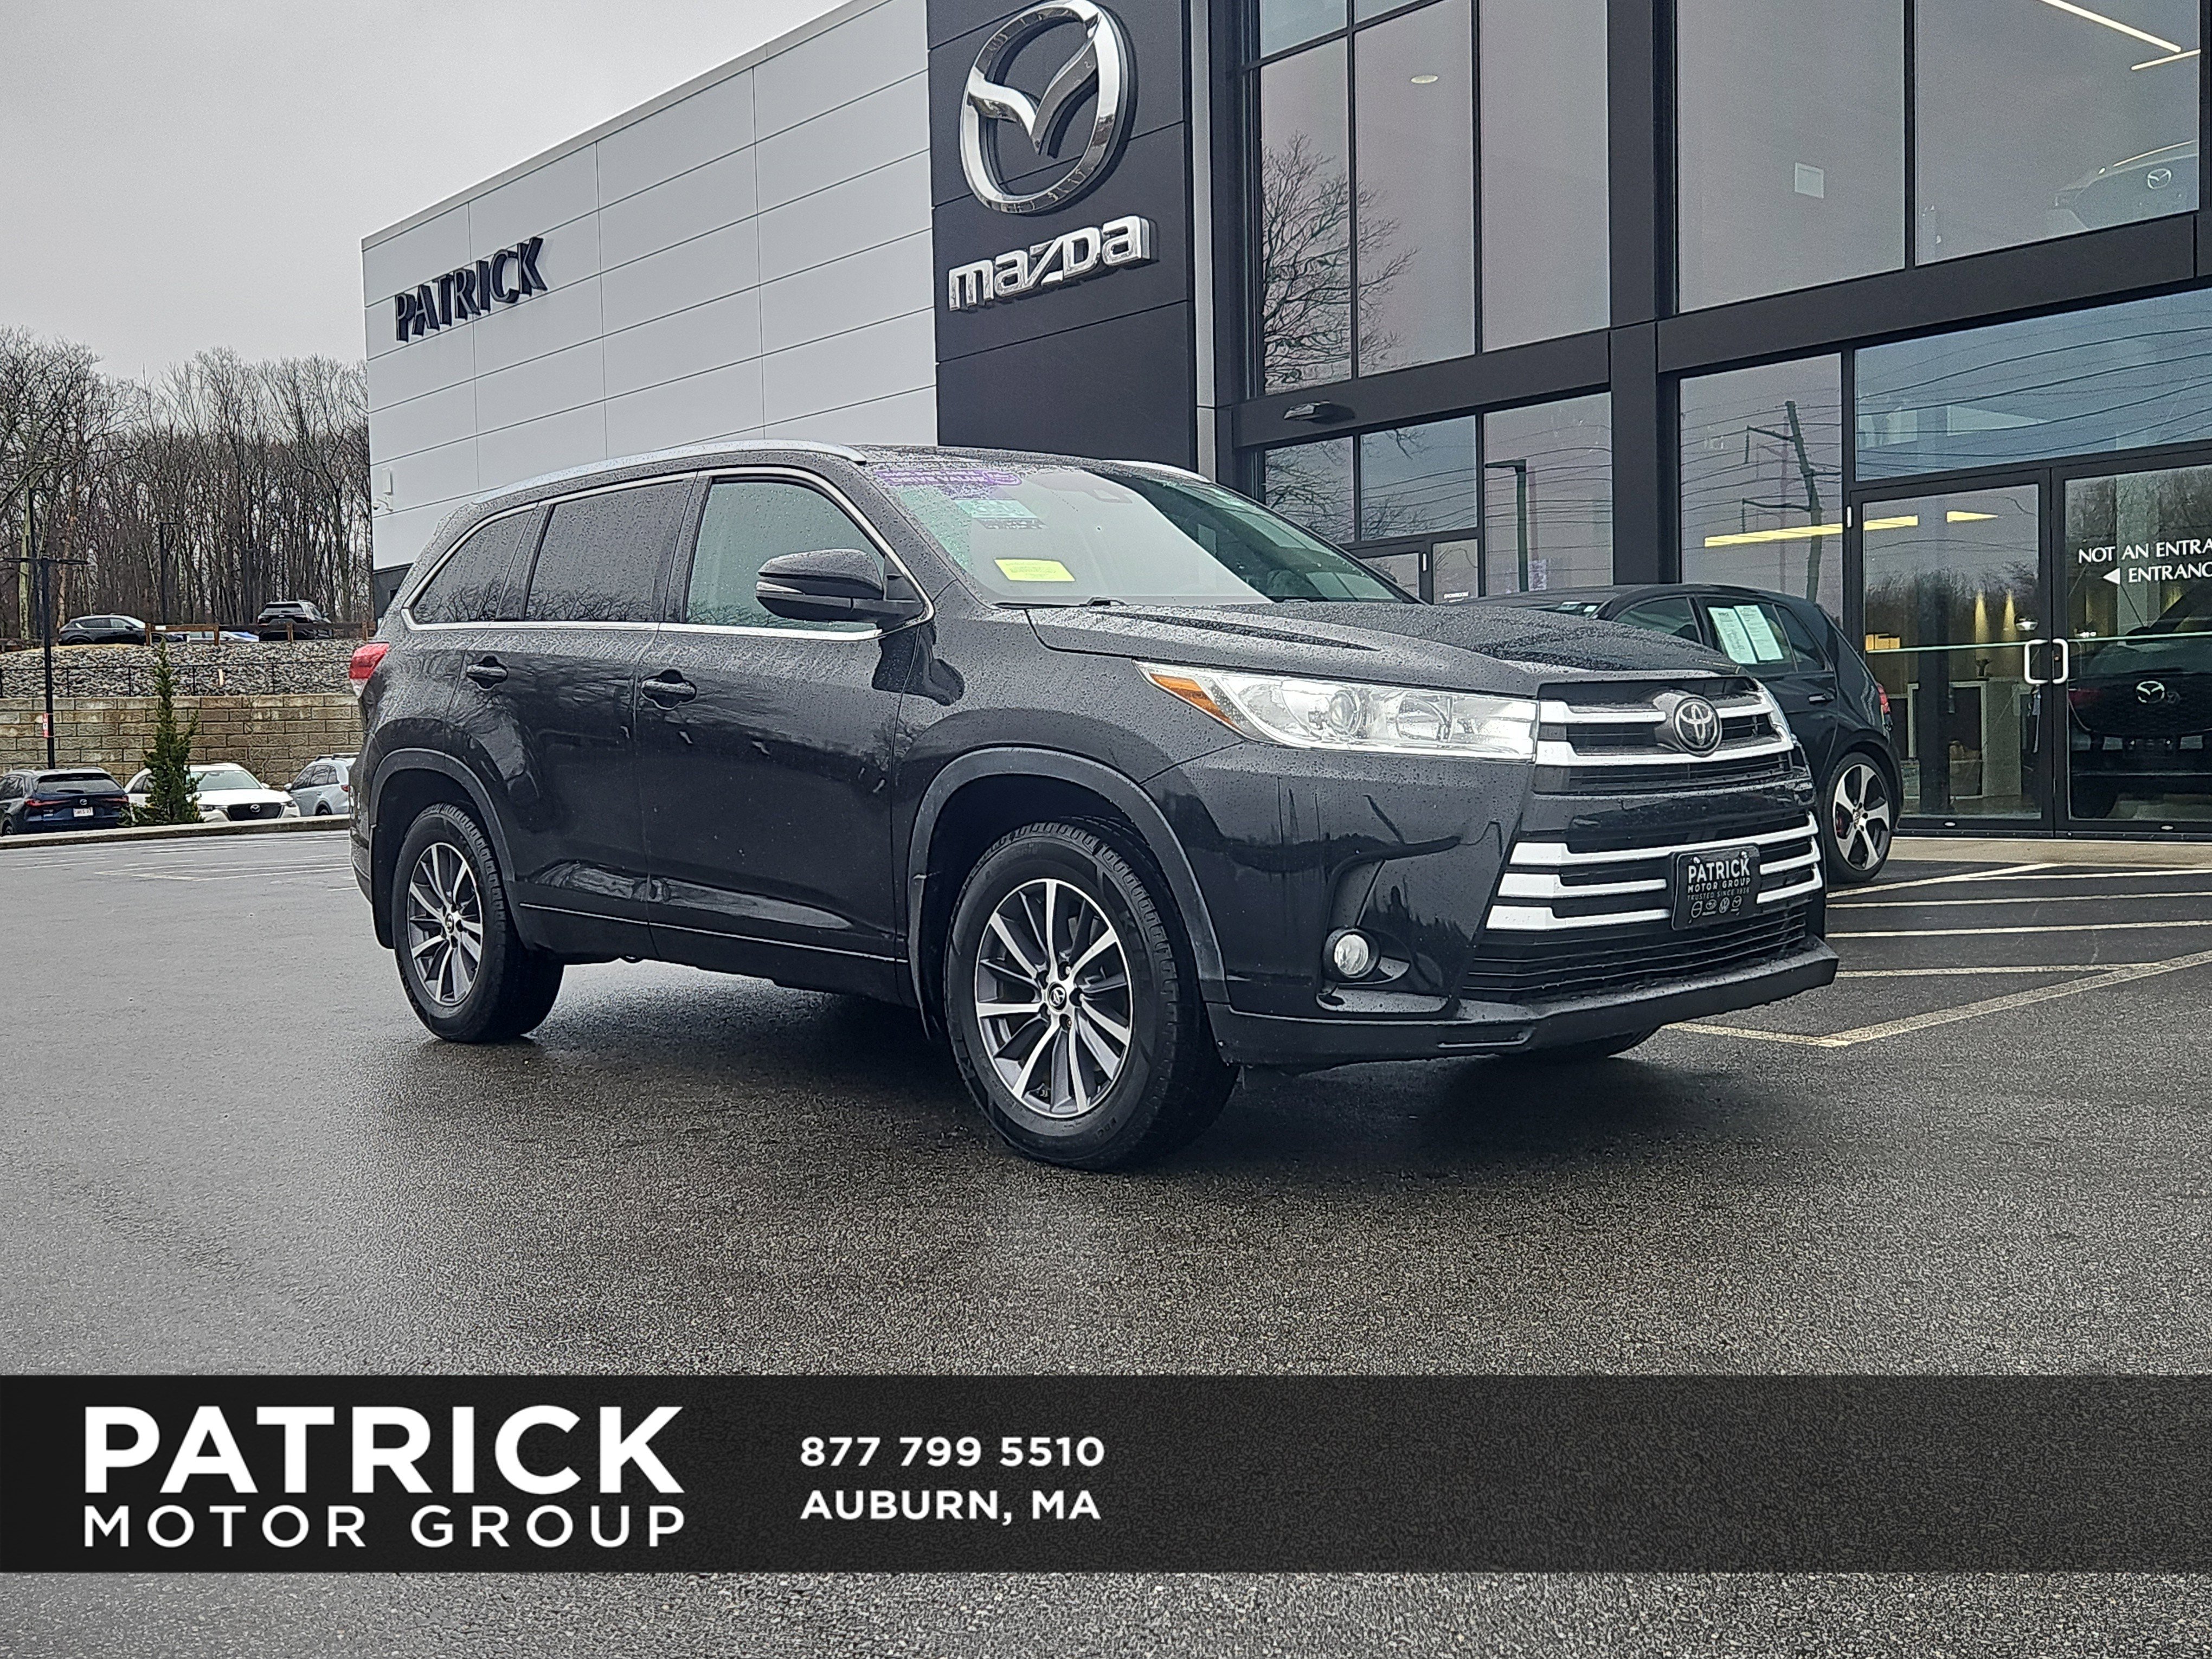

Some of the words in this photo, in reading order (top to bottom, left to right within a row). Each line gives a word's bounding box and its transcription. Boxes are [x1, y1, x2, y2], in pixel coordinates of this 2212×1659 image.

[395, 236, 548, 343] PATRICK
[2078, 546, 2115, 563] NOT
[2121, 543, 2149, 560] AN
[2156, 538, 2212, 557] ENTRA
[2128, 561, 2212, 583] ENTRANC
[1688, 858, 1750, 883] PATRICK
[1688, 882, 1718, 893] MOTOR
[1722, 877, 1751, 889] GROUP
